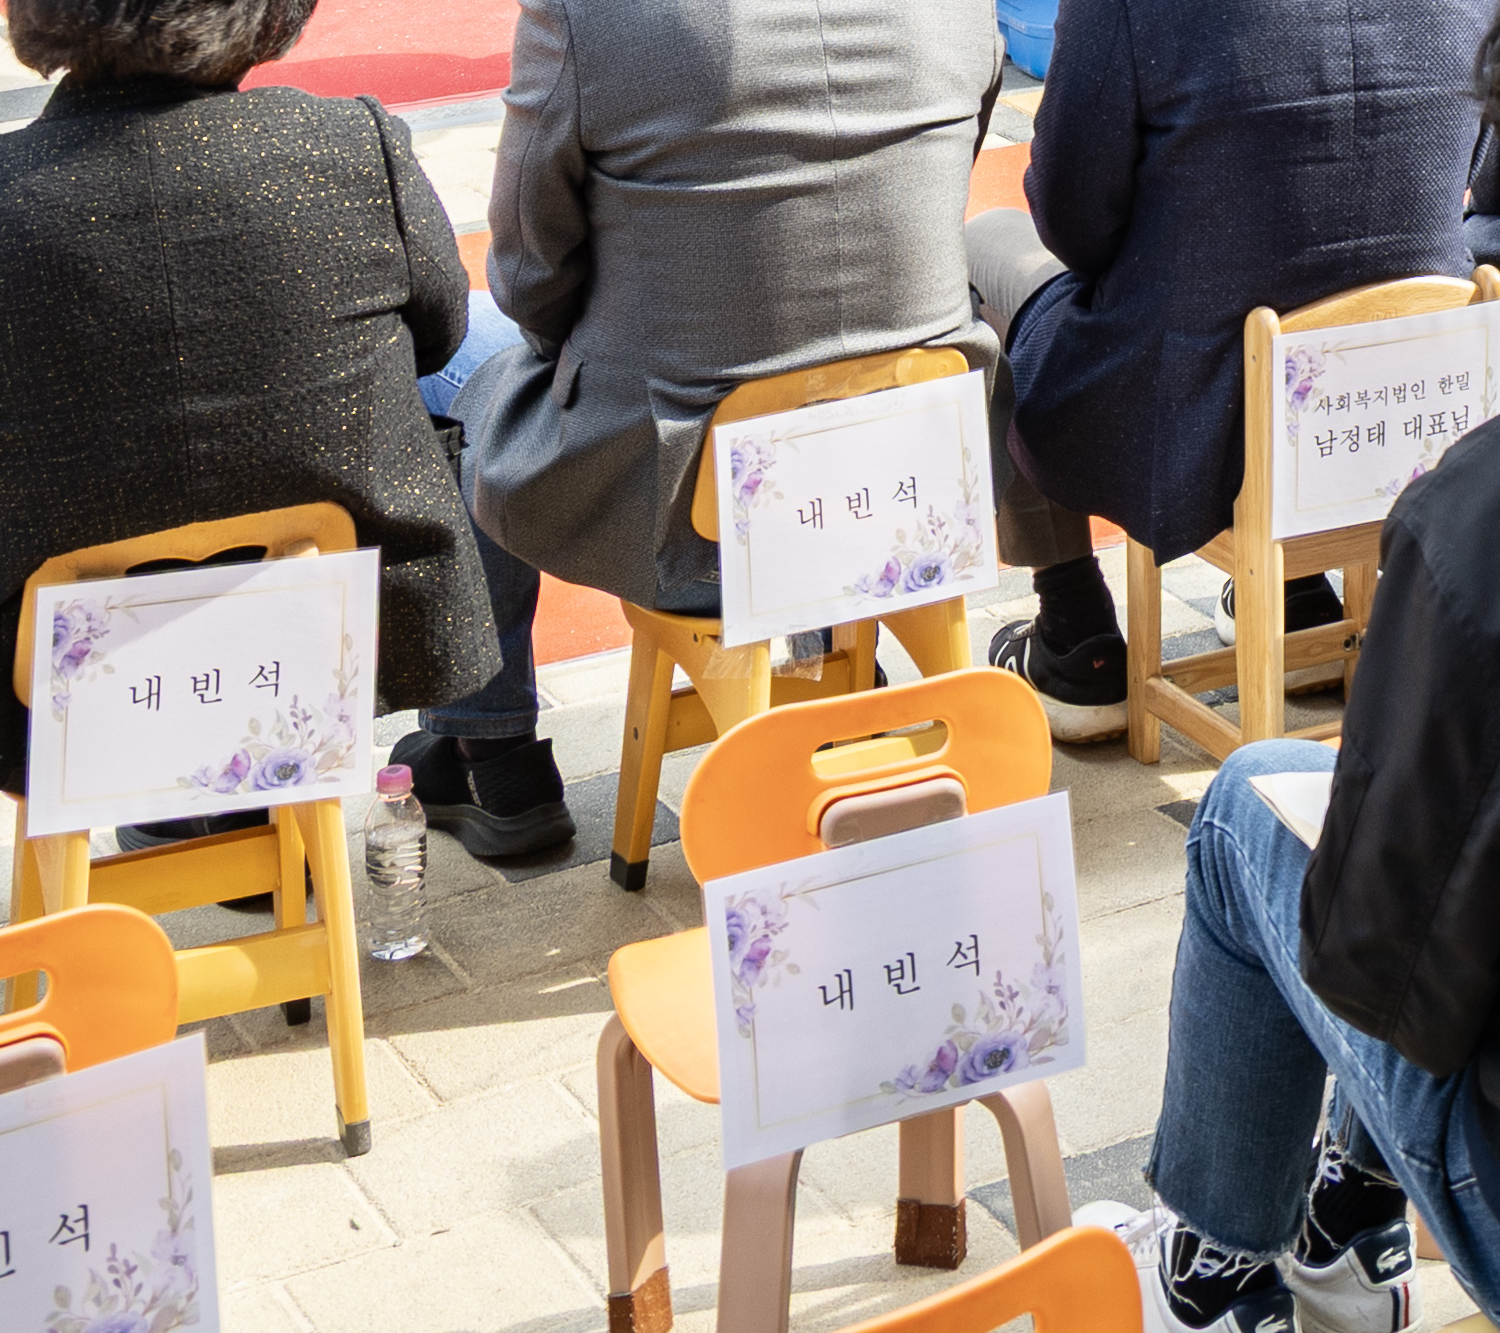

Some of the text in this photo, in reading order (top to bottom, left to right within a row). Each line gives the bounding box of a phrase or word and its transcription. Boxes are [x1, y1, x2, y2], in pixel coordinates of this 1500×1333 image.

[1314, 379, 1427, 417] 사회복지법인
[1313, 404, 1470, 458] 남정태 대표님
